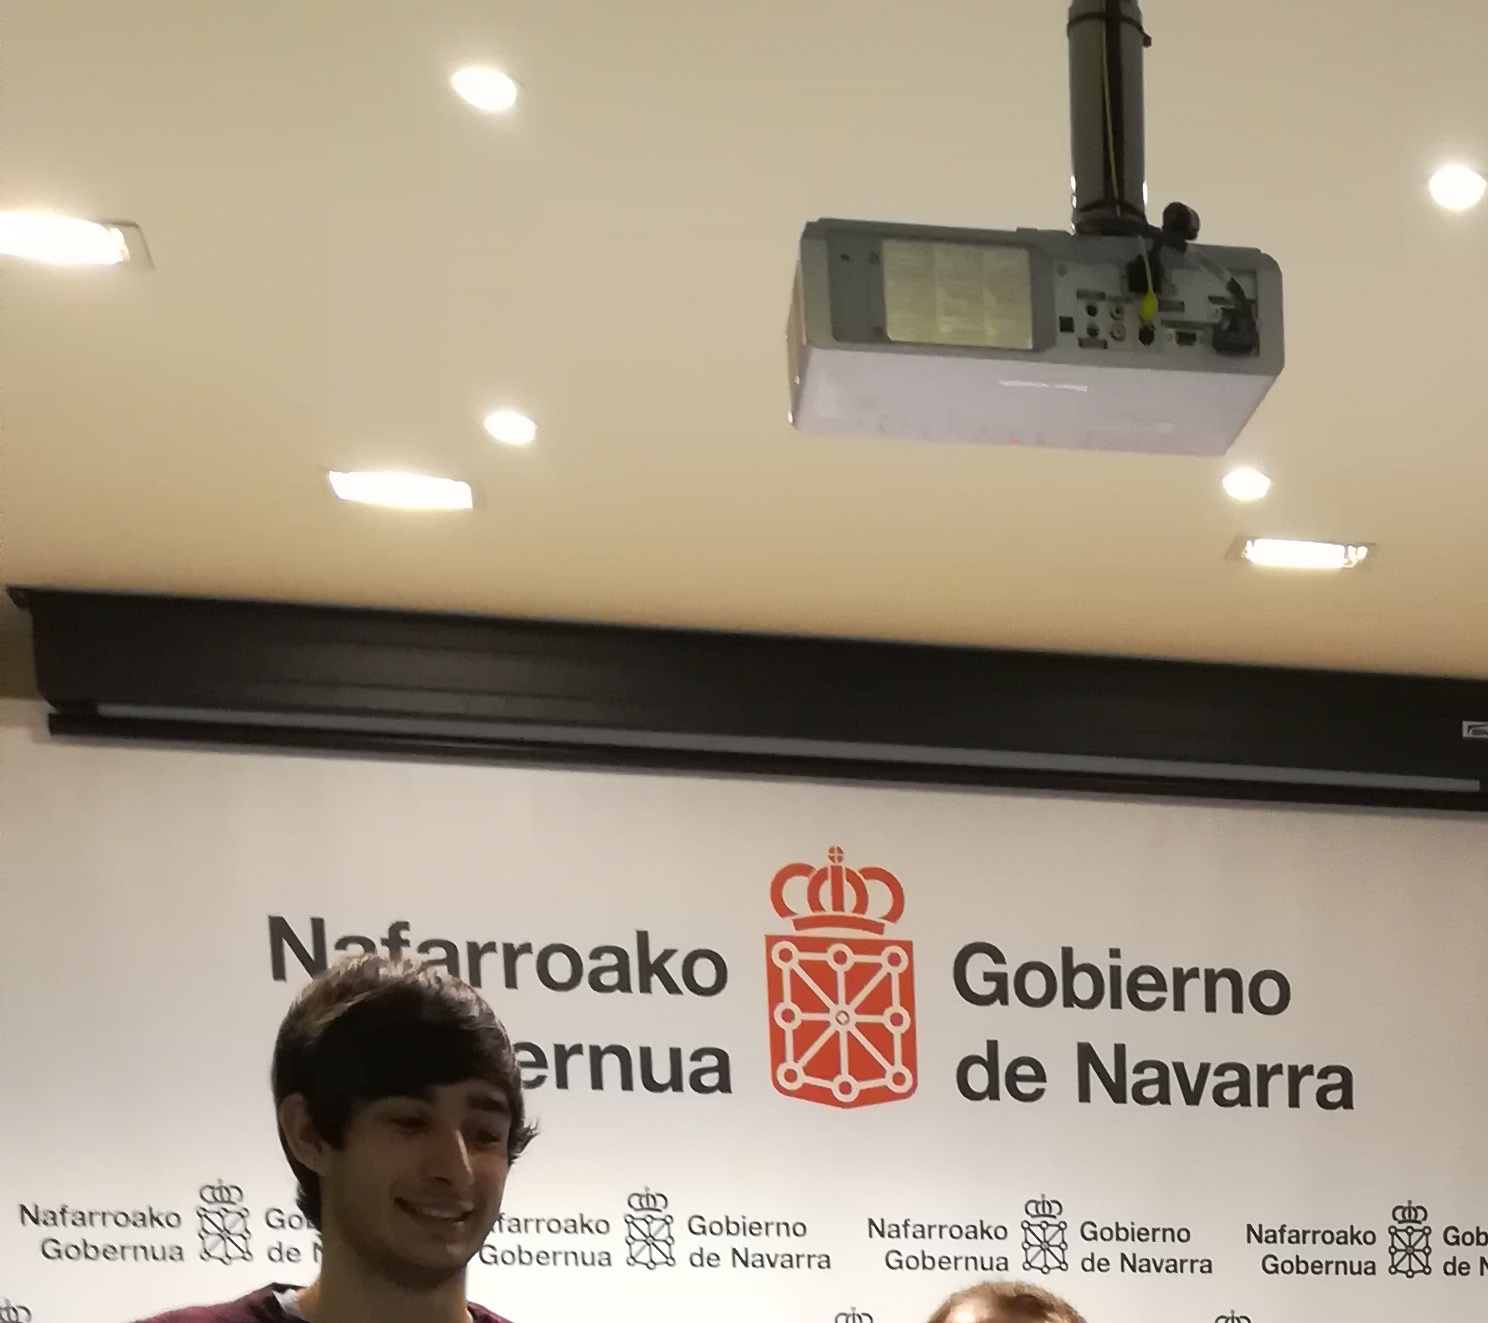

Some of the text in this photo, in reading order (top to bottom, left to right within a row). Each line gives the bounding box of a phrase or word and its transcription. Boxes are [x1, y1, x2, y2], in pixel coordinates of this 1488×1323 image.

[952, 941, 1292, 1017] Gobierno
[518, 1038, 732, 1096] ernua
[955, 1038, 1355, 1111] de Navarra
[18, 1202, 182, 1229] Nafarroako
[493, 1210, 614, 1236] farroako
[687, 1213, 808, 1238] Gobierno
[867, 1217, 1009, 1241] Nafarroako
[1079, 1220, 1192, 1244] Gobierno
[1246, 1223, 1377, 1247] Nafarroako
[39, 1236, 185, 1263] Gobernua
[265, 1239, 302, 1264] de
[478, 1242, 614, 1268] Gobernua
[688, 1246, 832, 1270] de Navarra
[884, 1248, 1010, 1273] Gobernua
[1080, 1251, 1213, 1275] de Navarra
[1261, 1253, 1377, 1277] Gobernua
[1442, 1255, 1472, 1277] de
